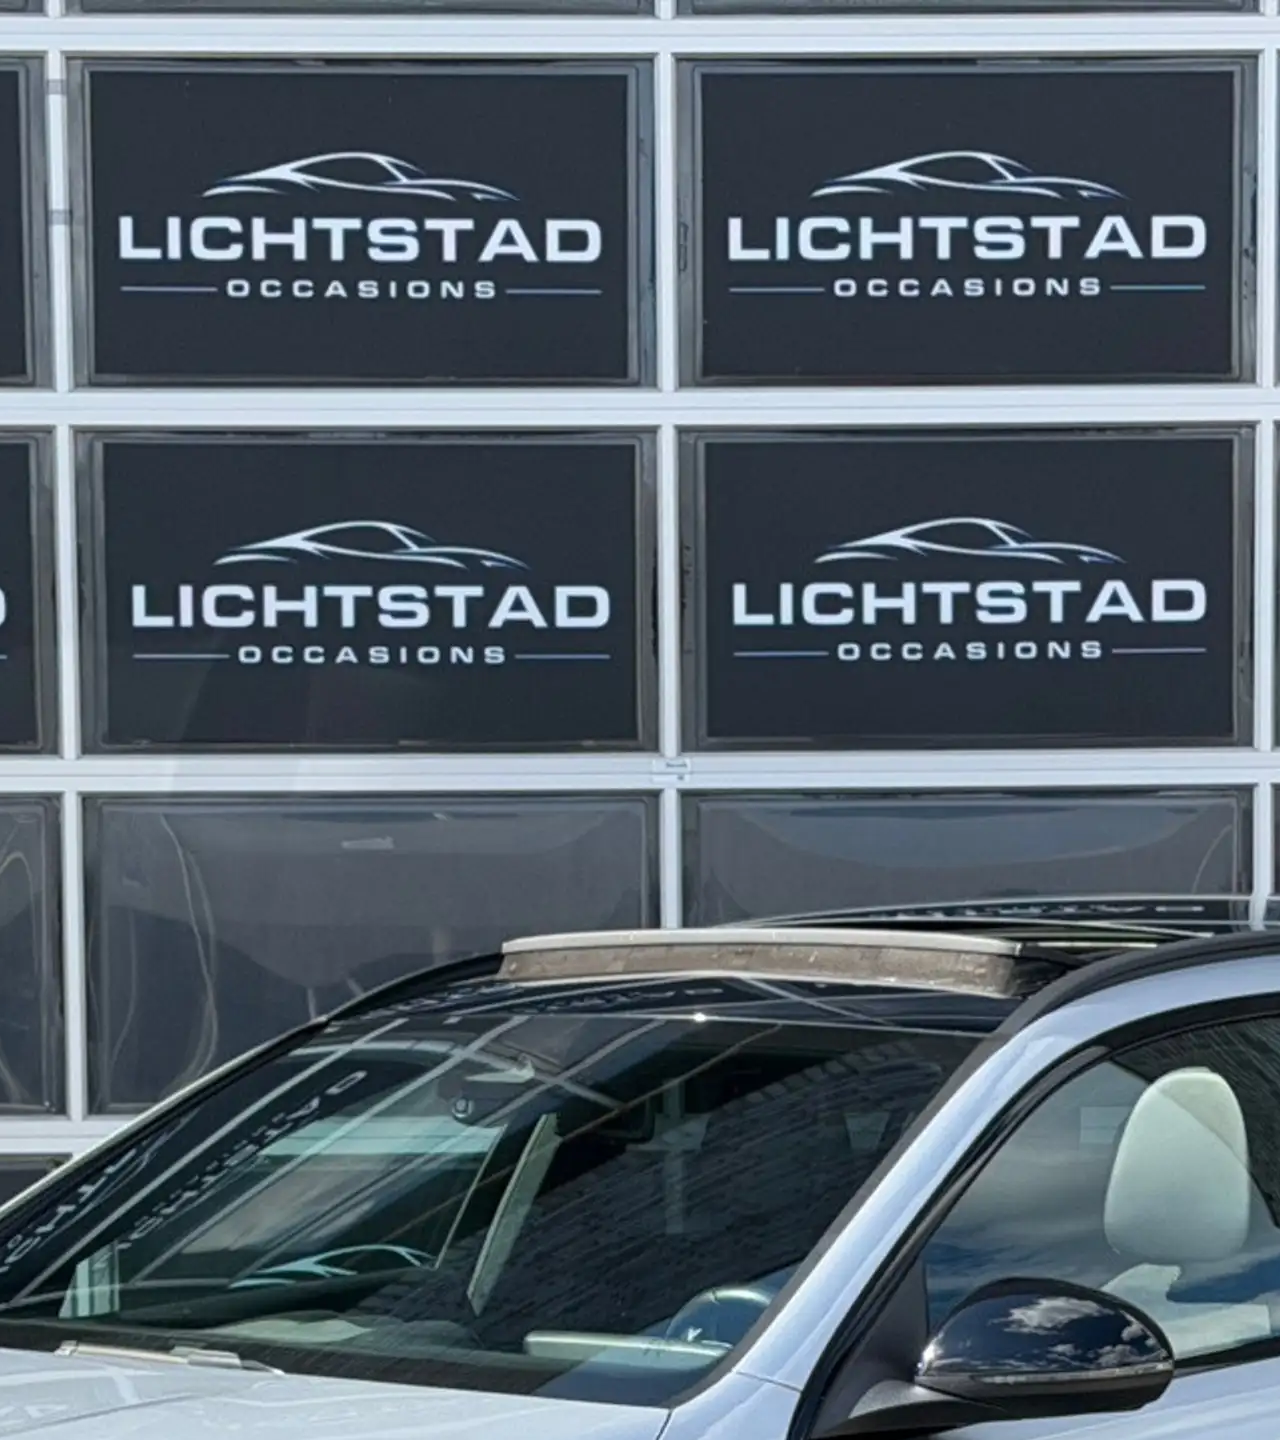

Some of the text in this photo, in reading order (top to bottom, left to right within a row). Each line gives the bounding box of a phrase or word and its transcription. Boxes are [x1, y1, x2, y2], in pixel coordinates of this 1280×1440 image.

[119, 217, 602, 263] LICHTSTAD
[728, 215, 1207, 262] LICHTSTAD
[226, 279, 496, 300] OCCASIONS
[834, 277, 1101, 298] OCCASIONS
[132, 584, 610, 629] LICHTSTAD
[733, 579, 1207, 625] LICHTSTAD
[238, 645, 506, 665] OCCASIONS
[837, 640, 1103, 661] OCCASIONS
